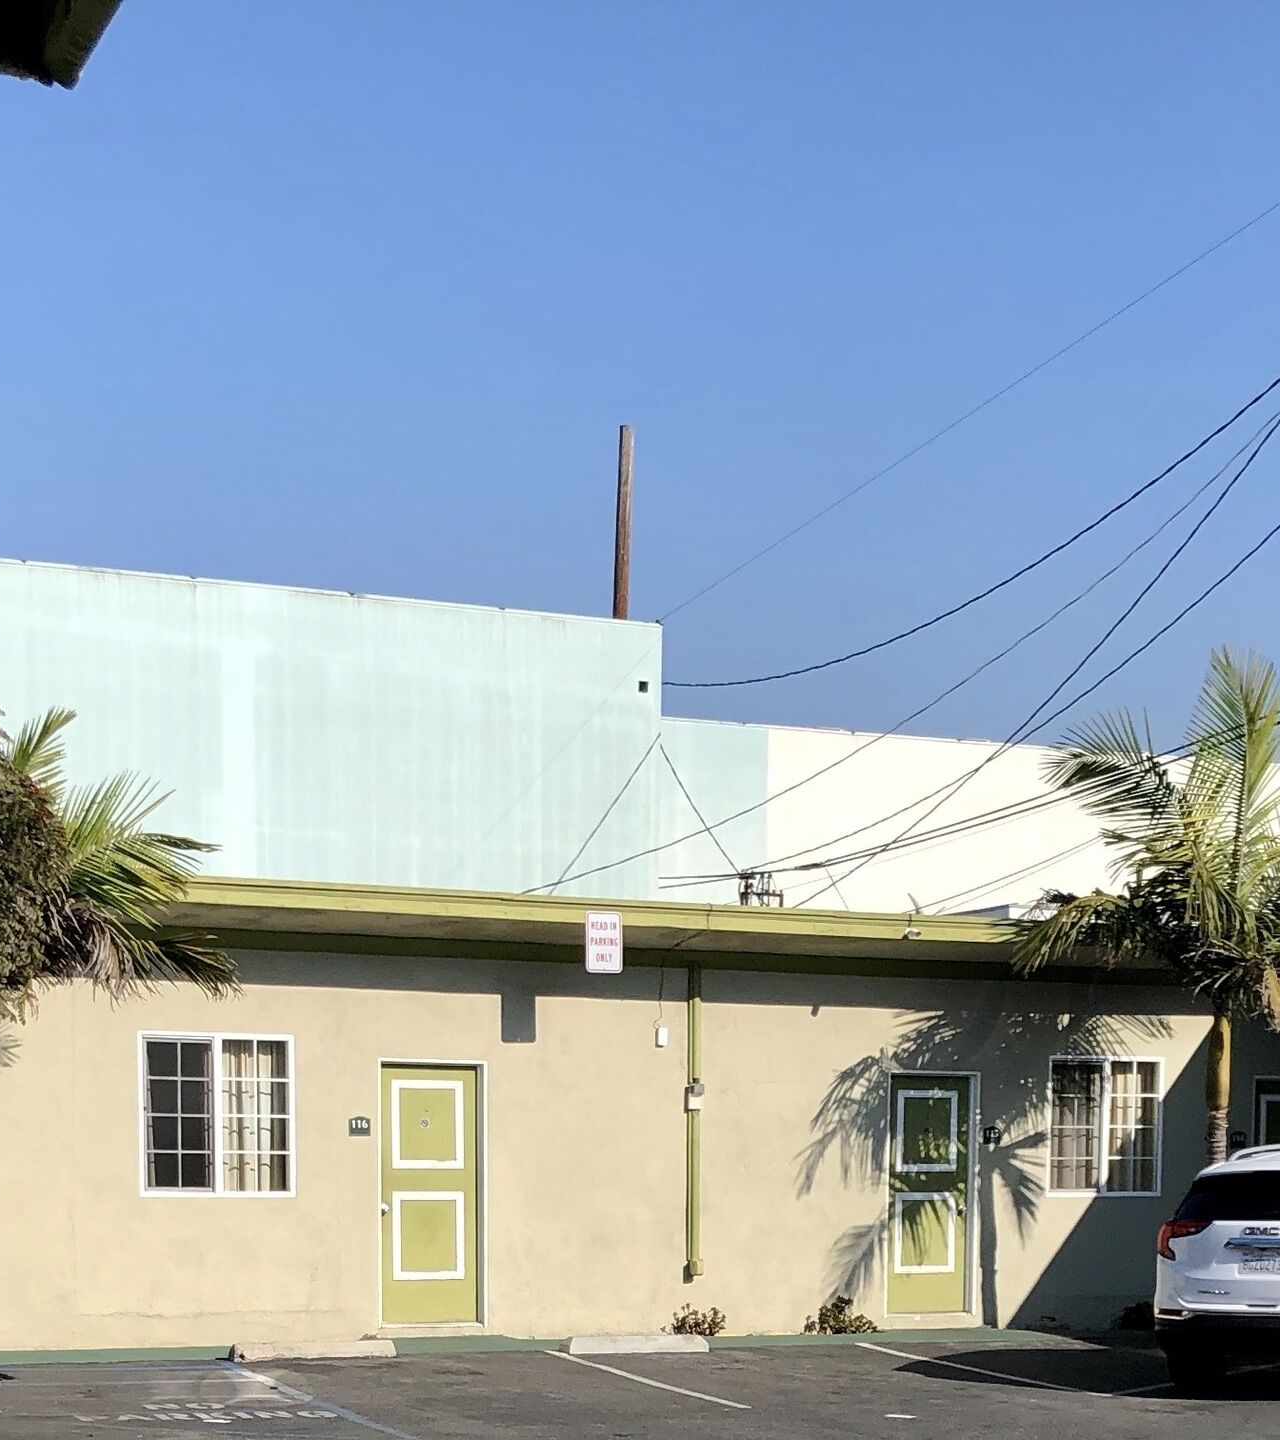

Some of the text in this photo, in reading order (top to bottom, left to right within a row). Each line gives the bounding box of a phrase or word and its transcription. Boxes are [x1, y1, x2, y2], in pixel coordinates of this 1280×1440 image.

[590, 921, 617, 931] HEAD IN
[590, 937, 619, 947] PARKING
[595, 953, 612, 962] ONLY
[351, 1119, 369, 1129] 116
[1244, 1226, 1280, 1236] GMC
[142, 1402, 226, 1411] NO
[72, 1409, 339, 1422] PARKING
